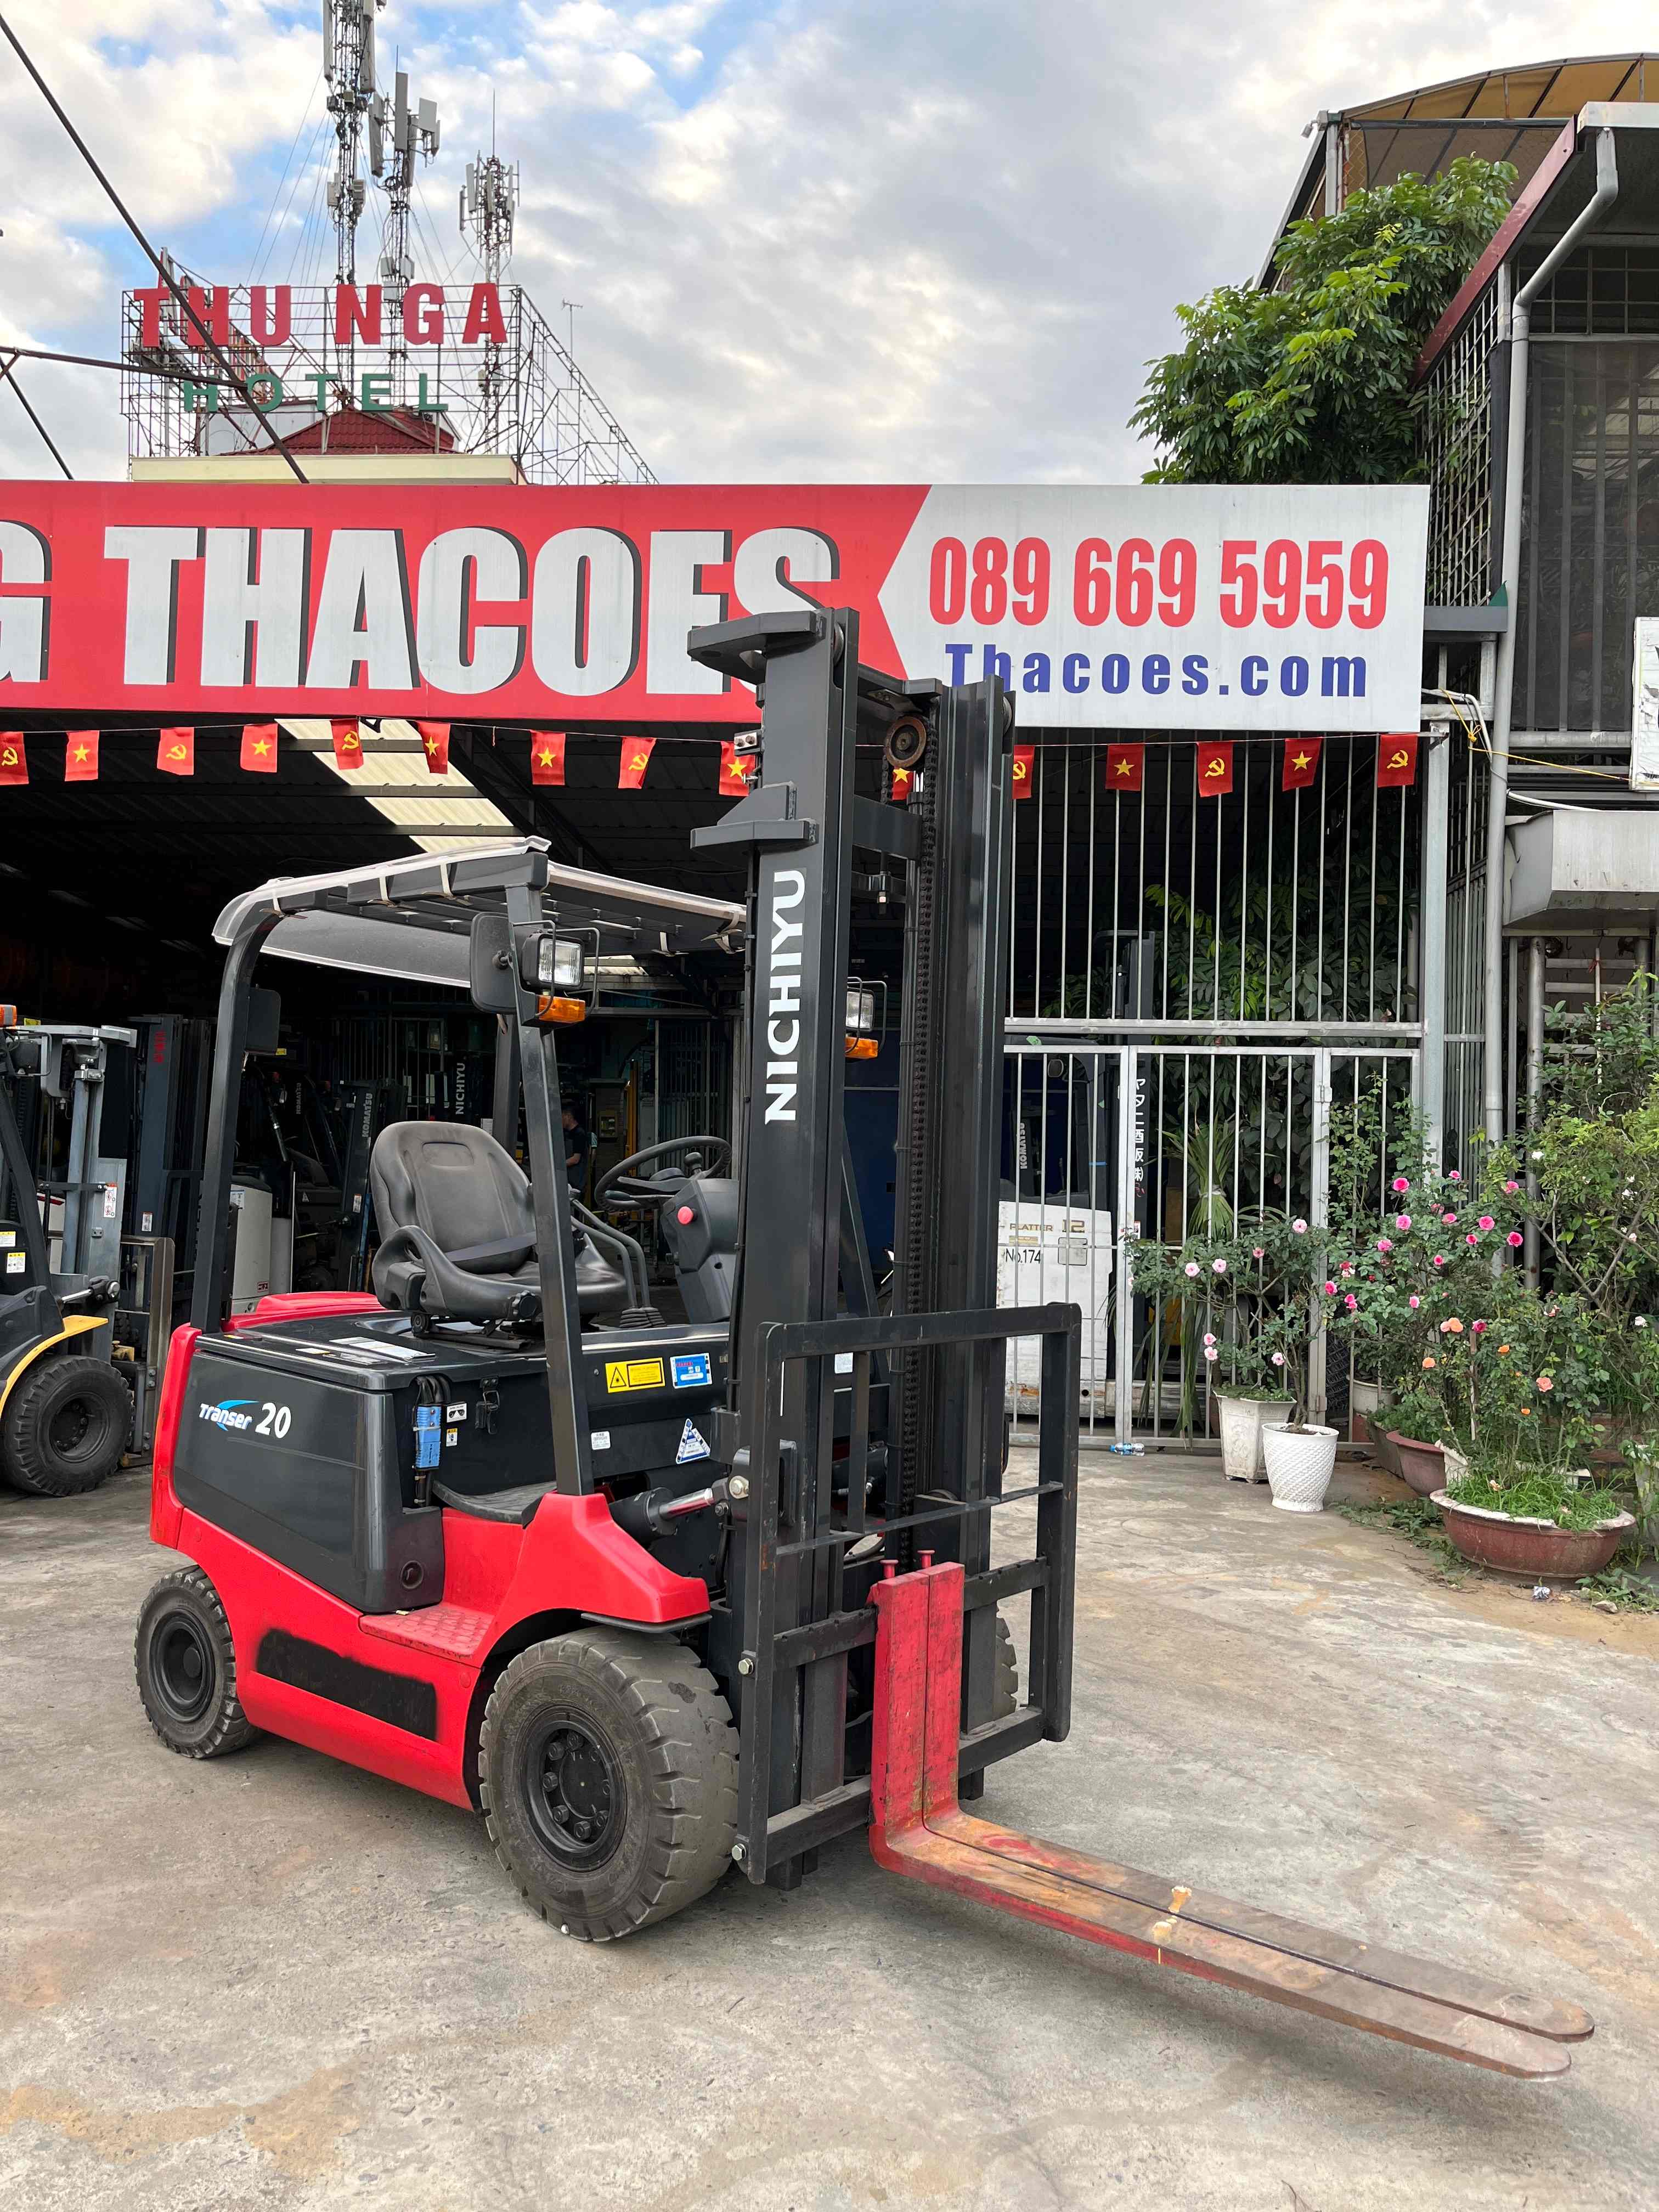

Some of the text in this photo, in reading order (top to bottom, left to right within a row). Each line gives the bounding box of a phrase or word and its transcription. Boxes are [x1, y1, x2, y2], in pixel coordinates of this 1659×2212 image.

[133, 282, 507, 348] THU NGA
[183, 373, 449, 413] HOTEL
[929, 537, 1389, 629] 089 669 5959
[945, 643, 1366, 698] Thacoes.com
[765, 870, 806, 1125] NICHIYU
[362, 1092, 373, 1137] KOMATSU
[455, 1062, 466, 1115] NICHIYU
[1019, 1122, 1028, 1170] KOMATSU
[199, 1402, 291, 1439] Transer 20
